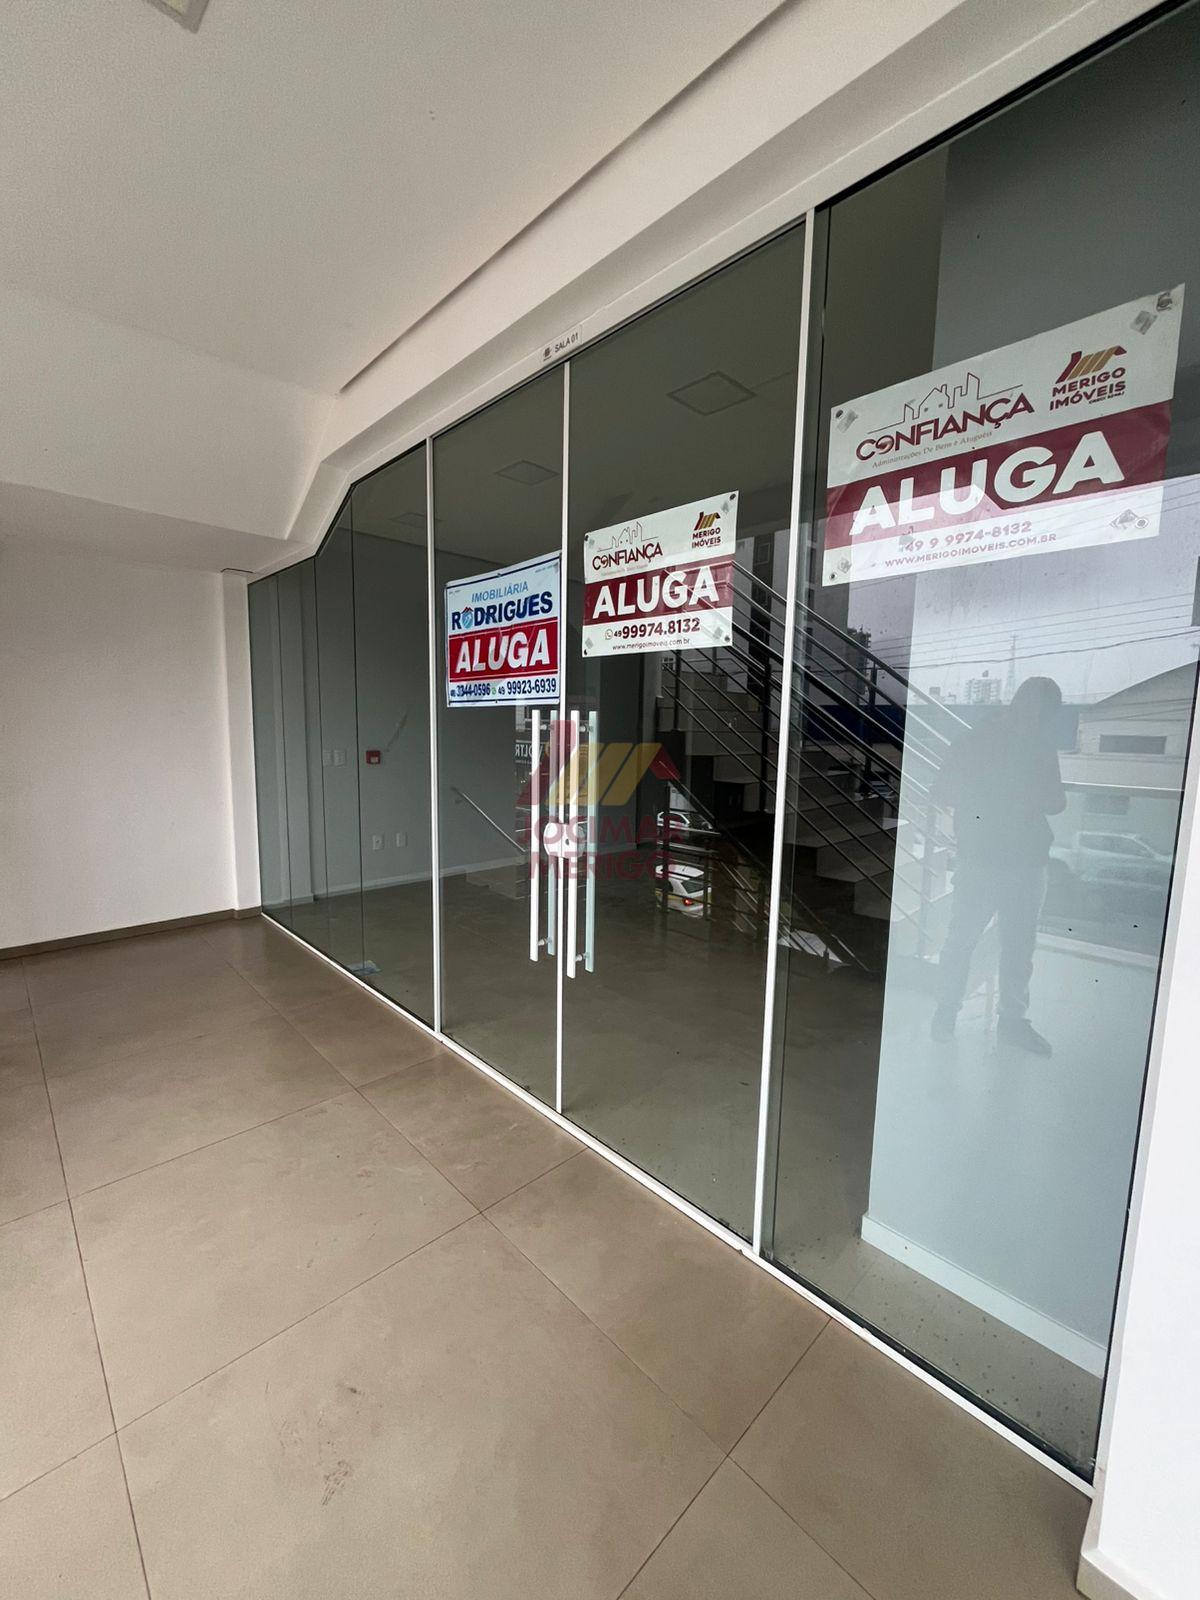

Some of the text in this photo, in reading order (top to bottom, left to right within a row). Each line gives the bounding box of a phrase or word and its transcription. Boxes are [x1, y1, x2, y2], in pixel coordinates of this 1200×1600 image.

[555, 337, 570, 352] SALA
[1049, 381, 1126, 411] IMÓVEIS
[1052, 367, 1126, 397] MERIGO
[855, 393, 1034, 461] CONFIANÇA
[849, 431, 1125, 536] ALUGA
[691, 536, 721, 549] IMÓVEIS
[692, 527, 721, 539] MERIGO
[945, 521, 1032, 545] 9974-8132
[592, 542, 663, 571] CONFIANÇA
[885, 533, 1057, 567] WWW.MERIGOIMOVEIS.COM.BR
[592, 566, 720, 620] ALUGA
[451, 591, 553, 630] RODRIGUES
[622, 618, 700, 639] 99974.8132
[455, 628, 550, 674] ALUGA
[507, 678, 557, 694] 99923-6939
